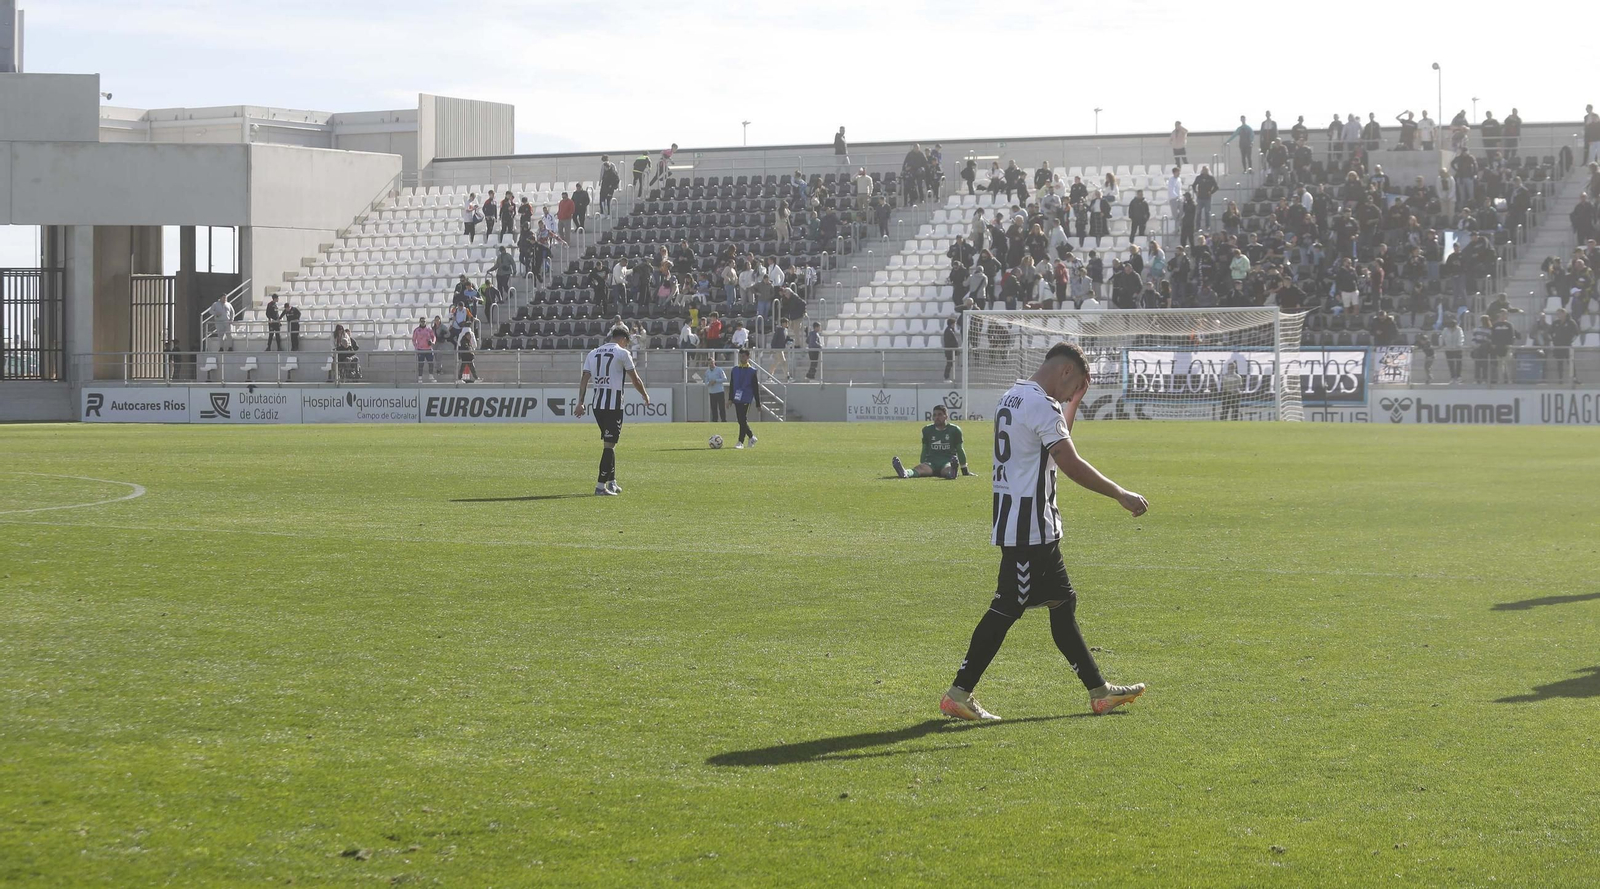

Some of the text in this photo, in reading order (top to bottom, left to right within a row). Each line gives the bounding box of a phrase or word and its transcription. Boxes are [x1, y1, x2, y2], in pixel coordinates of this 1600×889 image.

[594, 353, 614, 376] 17
[111, 399, 186, 411] Autocares Ríos
[239, 392, 287, 406] Diputación
[303, 395, 345, 410] Hospital
[239, 408, 279, 420] de Cádiz
[425, 396, 538, 418] EUROSHIP
[848, 405, 889, 415] EVENTOS
[894, 406, 916, 416] RUIZ
[1416, 397, 1520, 424] hummel
[357, 412, 418, 421] Campo de Gibraltar
